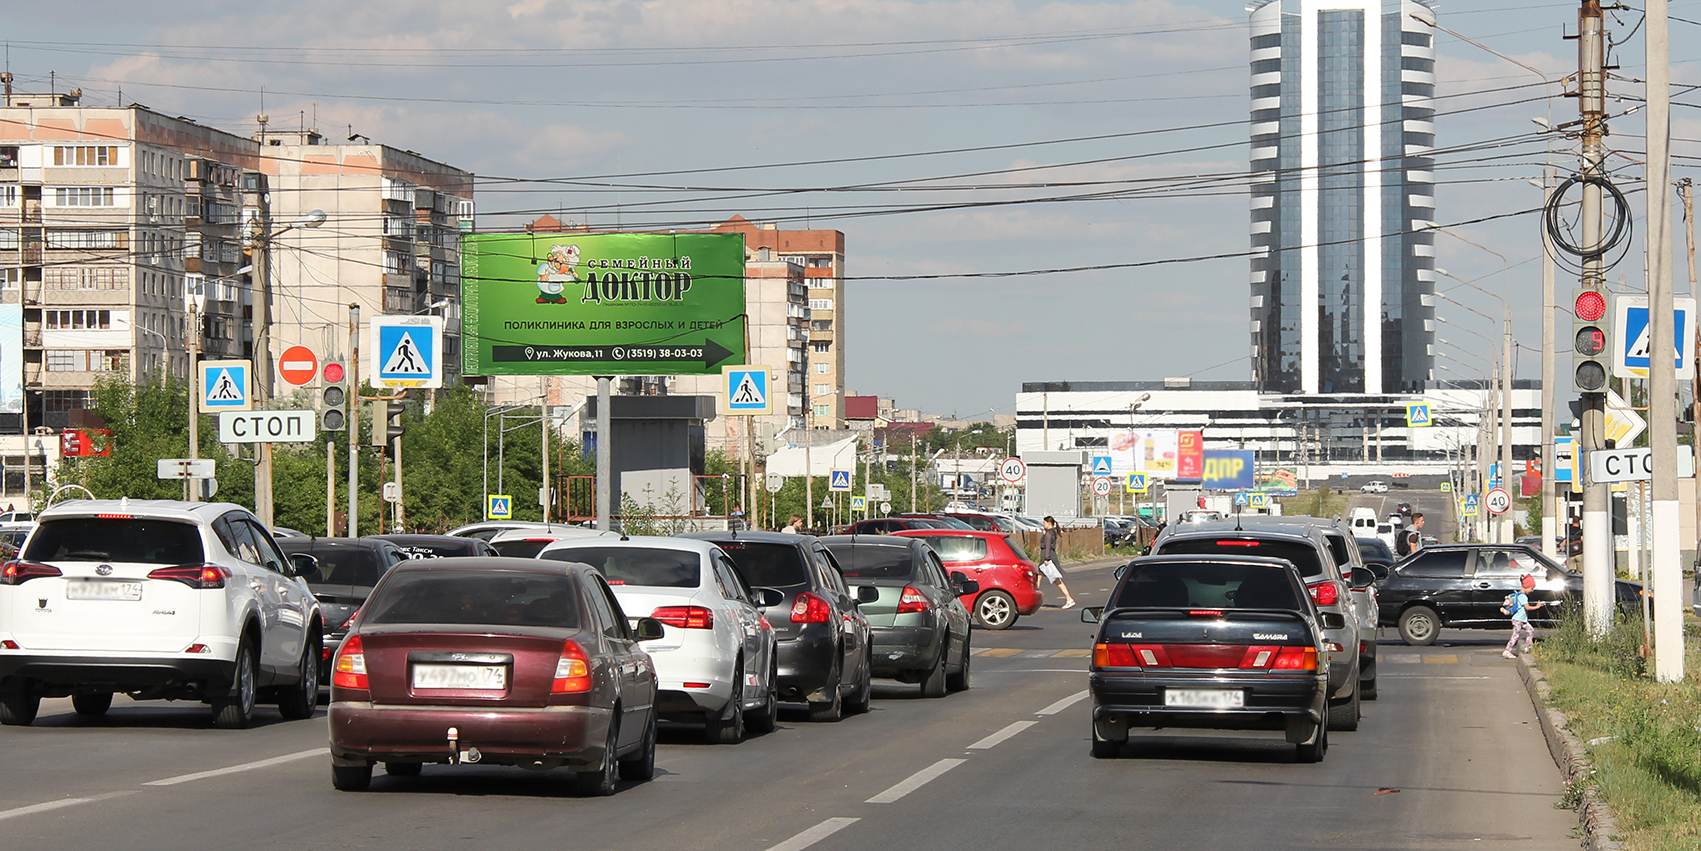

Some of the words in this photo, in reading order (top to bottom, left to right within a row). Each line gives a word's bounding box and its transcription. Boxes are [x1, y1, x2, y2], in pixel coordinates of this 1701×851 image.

[587, 256, 691, 269] СЕМЕЙНЫЙ
[581, 271, 692, 304] ДОКТОР
[504, 320, 586, 330] ПОЛИКЛИНИКА
[589, 320, 611, 331] ДЛЯ
[615, 320, 674, 330] ВЗРОСЛЫХ
[677, 320, 686, 329] И
[689, 318, 723, 330] ДЕТЕЙ
[1592, 331, 1603, 350] 9
[536, 350, 550, 360] ул.
[553, 349, 603, 358] Жукова,11
[627, 349, 656, 359] (3519)
[659, 349, 703, 358] 38-03-03
[232, 416, 301, 437] СТОП
[1005, 465, 1020, 475] 40
[1605, 453, 1652, 476] СТО
[1096, 482, 1109, 491] 20
[1490, 496, 1506, 507] 40
[412, 546, 433, 554] Такси
[1252, 633, 1288, 641] SAMARA
